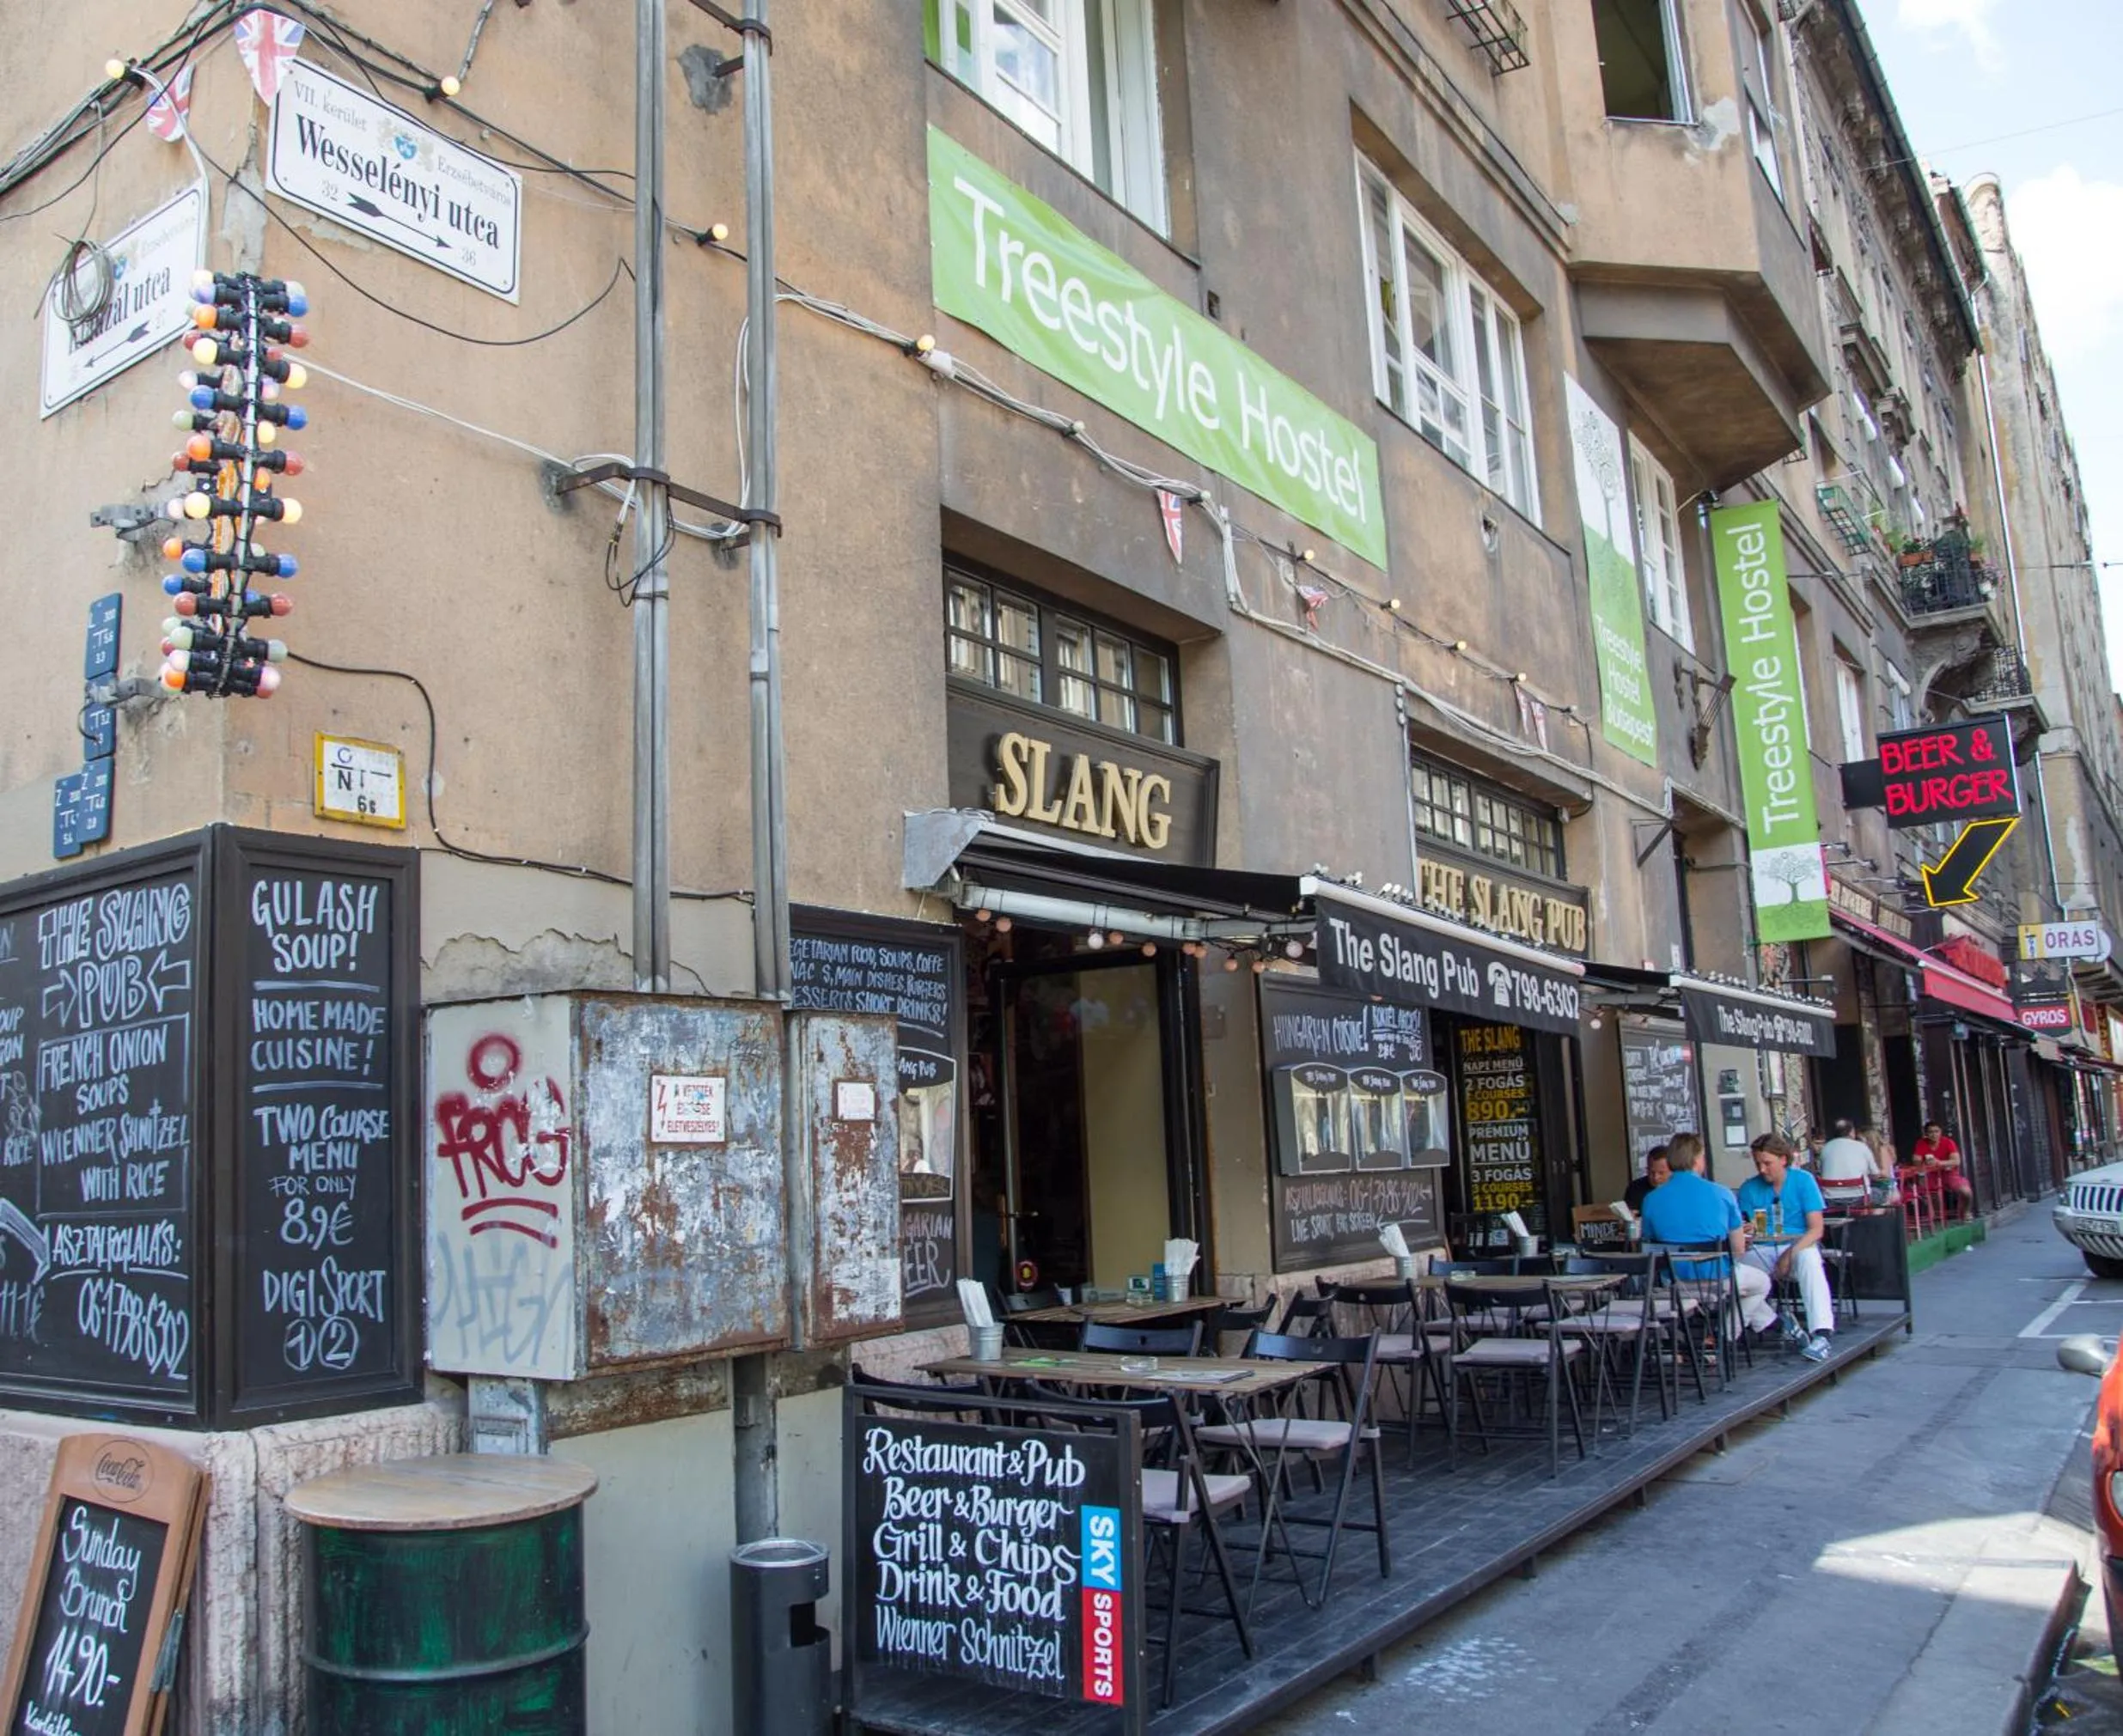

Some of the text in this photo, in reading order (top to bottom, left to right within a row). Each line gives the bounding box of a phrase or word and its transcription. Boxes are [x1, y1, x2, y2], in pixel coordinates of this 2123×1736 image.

[294, 81, 369, 131] VII. kerület
[296, 113, 500, 250] Wesselényi utca
[320, 180, 340, 203] 32
[134, 265, 171, 314] utca
[954, 175, 1367, 524] Treestyle Hostel
[1595, 613, 1642, 674] Treestyle
[1608, 658, 1642, 707] Hostel
[1725, 521, 1799, 835] Treestyle Hostel
[1605, 693, 1654, 748] Budapest
[1879, 728, 1998, 776] BEER &
[994, 731, 1172, 850] SLANG
[1884, 769, 2016, 816] BURGER
[38, 897, 95, 970] THE
[95, 882, 191, 961] SLANG
[251, 879, 379, 939] GULASH
[1416, 856, 1587, 952] THE SLANG PUB
[271, 929, 359, 973] SOUP!
[789, 937, 849, 963] EGETARIAN
[1329, 917, 1581, 1020] The Slang Pub 798-6302
[77, 955, 148, 1029] PUB
[252, 998, 386, 1035] HOME MADE
[792, 985, 853, 1011] ESSERTS
[0, 1006, 24, 1032] OUP
[1461, 1026, 1521, 1054] THE SLANG
[2022, 1008, 2066, 1026] GYROS
[41, 1031, 104, 1093] FRENCH
[109, 1023, 168, 1075] ONION
[1465, 1071, 1525, 1091] 2 FOGÁS
[76, 1074, 129, 1115] SOUPS
[1474, 1088, 1526, 1101] COURSES
[41, 1118, 119, 1166] WIENNER
[253, 1103, 390, 1147] TWO COURSE
[1468, 1120, 1529, 1139] PRÉMIUM
[1469, 1136, 1531, 1162] MENÜ
[80, 1160, 170, 1203] WITH RICE
[289, 1141, 359, 1174] MENU
[1472, 1164, 1533, 1183] 3 FOGÁS
[267, 1174, 357, 1201] FOR ONLY
[1481, 1181, 1534, 1194] COURSES
[280, 1197, 355, 1252] 8.9€
[902, 1211, 954, 1245] GARIAN
[263, 1267, 315, 1319] DIGI
[319, 1255, 387, 1324] SPORT
[903, 1240, 951, 1290] EER
[863, 1426, 1010, 1478] Restaurant
[1021, 1439, 1087, 1488] Pub
[882, 1476, 1075, 1538] Beer & Burger
[62, 1505, 142, 1602] Sunday
[873, 1522, 1083, 1587] Grill & Chips
[1089, 1514, 1116, 1587] SKY
[59, 1568, 133, 1634] Brunch
[875, 1561, 1066, 1622] Drink & Food
[875, 1604, 1065, 1681] Wienner Schnitzel
[1092, 1591, 1113, 1699] SPORTS
